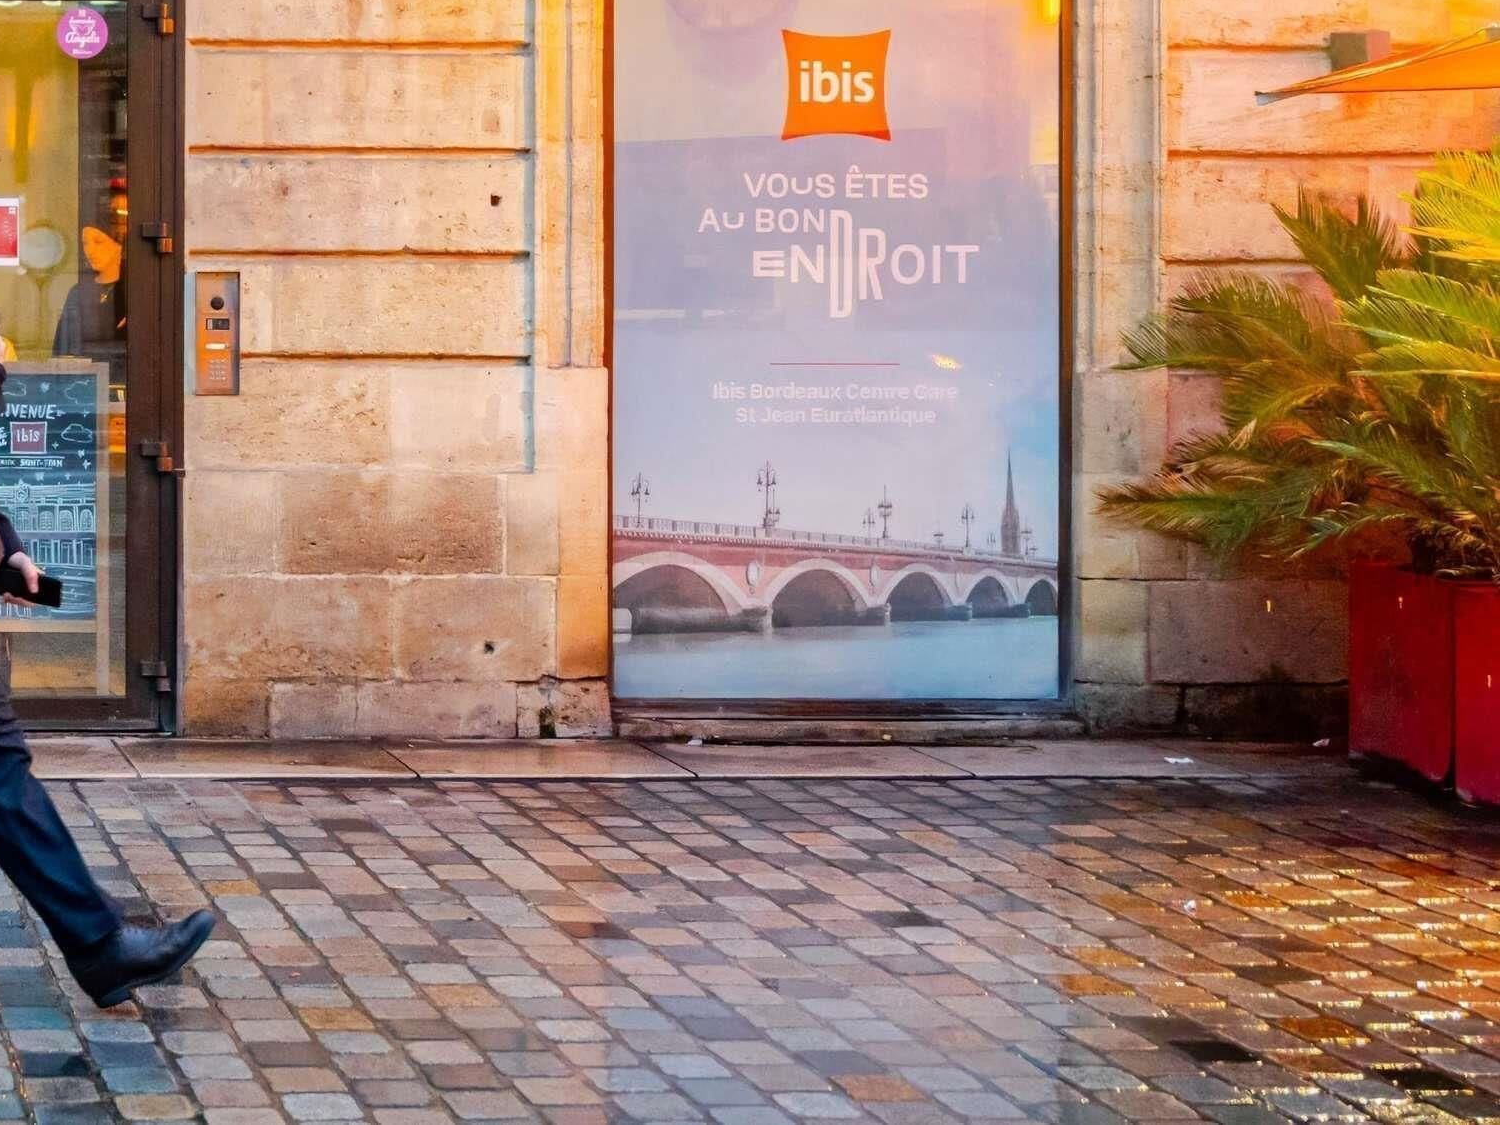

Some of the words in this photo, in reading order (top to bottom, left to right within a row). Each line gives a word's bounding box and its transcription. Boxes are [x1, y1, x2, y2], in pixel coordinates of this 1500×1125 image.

[800, 60, 875, 103] ibis
[743, 173, 836, 198] VOUS
[845, 164, 929, 198] ÊTES
[698, 208, 745, 233] AU
[755, 208, 825, 233] BON
[752, 209, 980, 318] ENDROIT
[713, 381, 746, 400] Ibis
[750, 381, 841, 400] Bordeaux
[846, 382, 909, 400] Centre
[736, 406, 756, 423] St
[761, 407, 805, 424] Jean
[810, 405, 936, 426] Euratlantique
